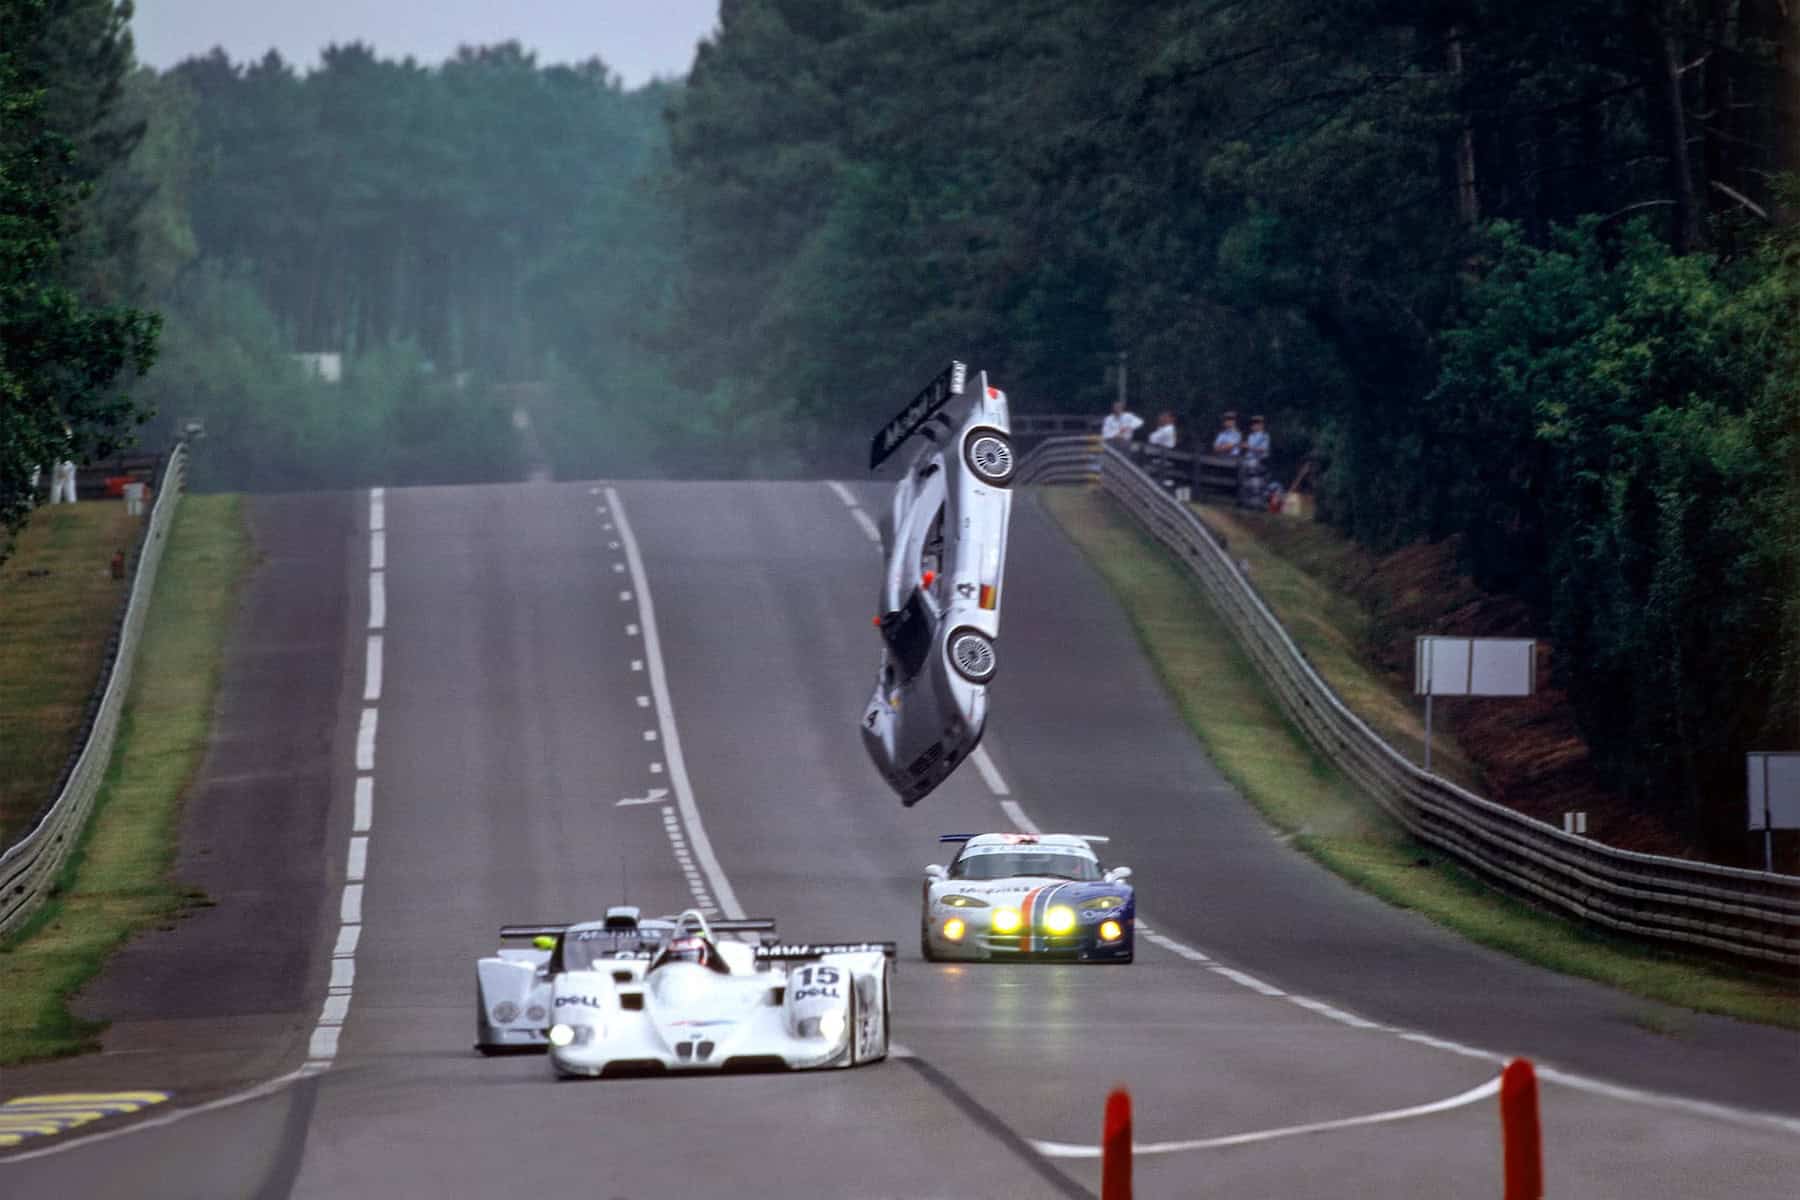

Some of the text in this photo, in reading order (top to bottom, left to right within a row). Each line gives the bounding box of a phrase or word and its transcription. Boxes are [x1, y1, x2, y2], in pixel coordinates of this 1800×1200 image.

[957, 582, 976, 599] 4
[866, 709, 880, 729] 4
[800, 965, 840, 987] 15
[554, 995, 601, 1009] DELL
[795, 986, 841, 1002] DELL
